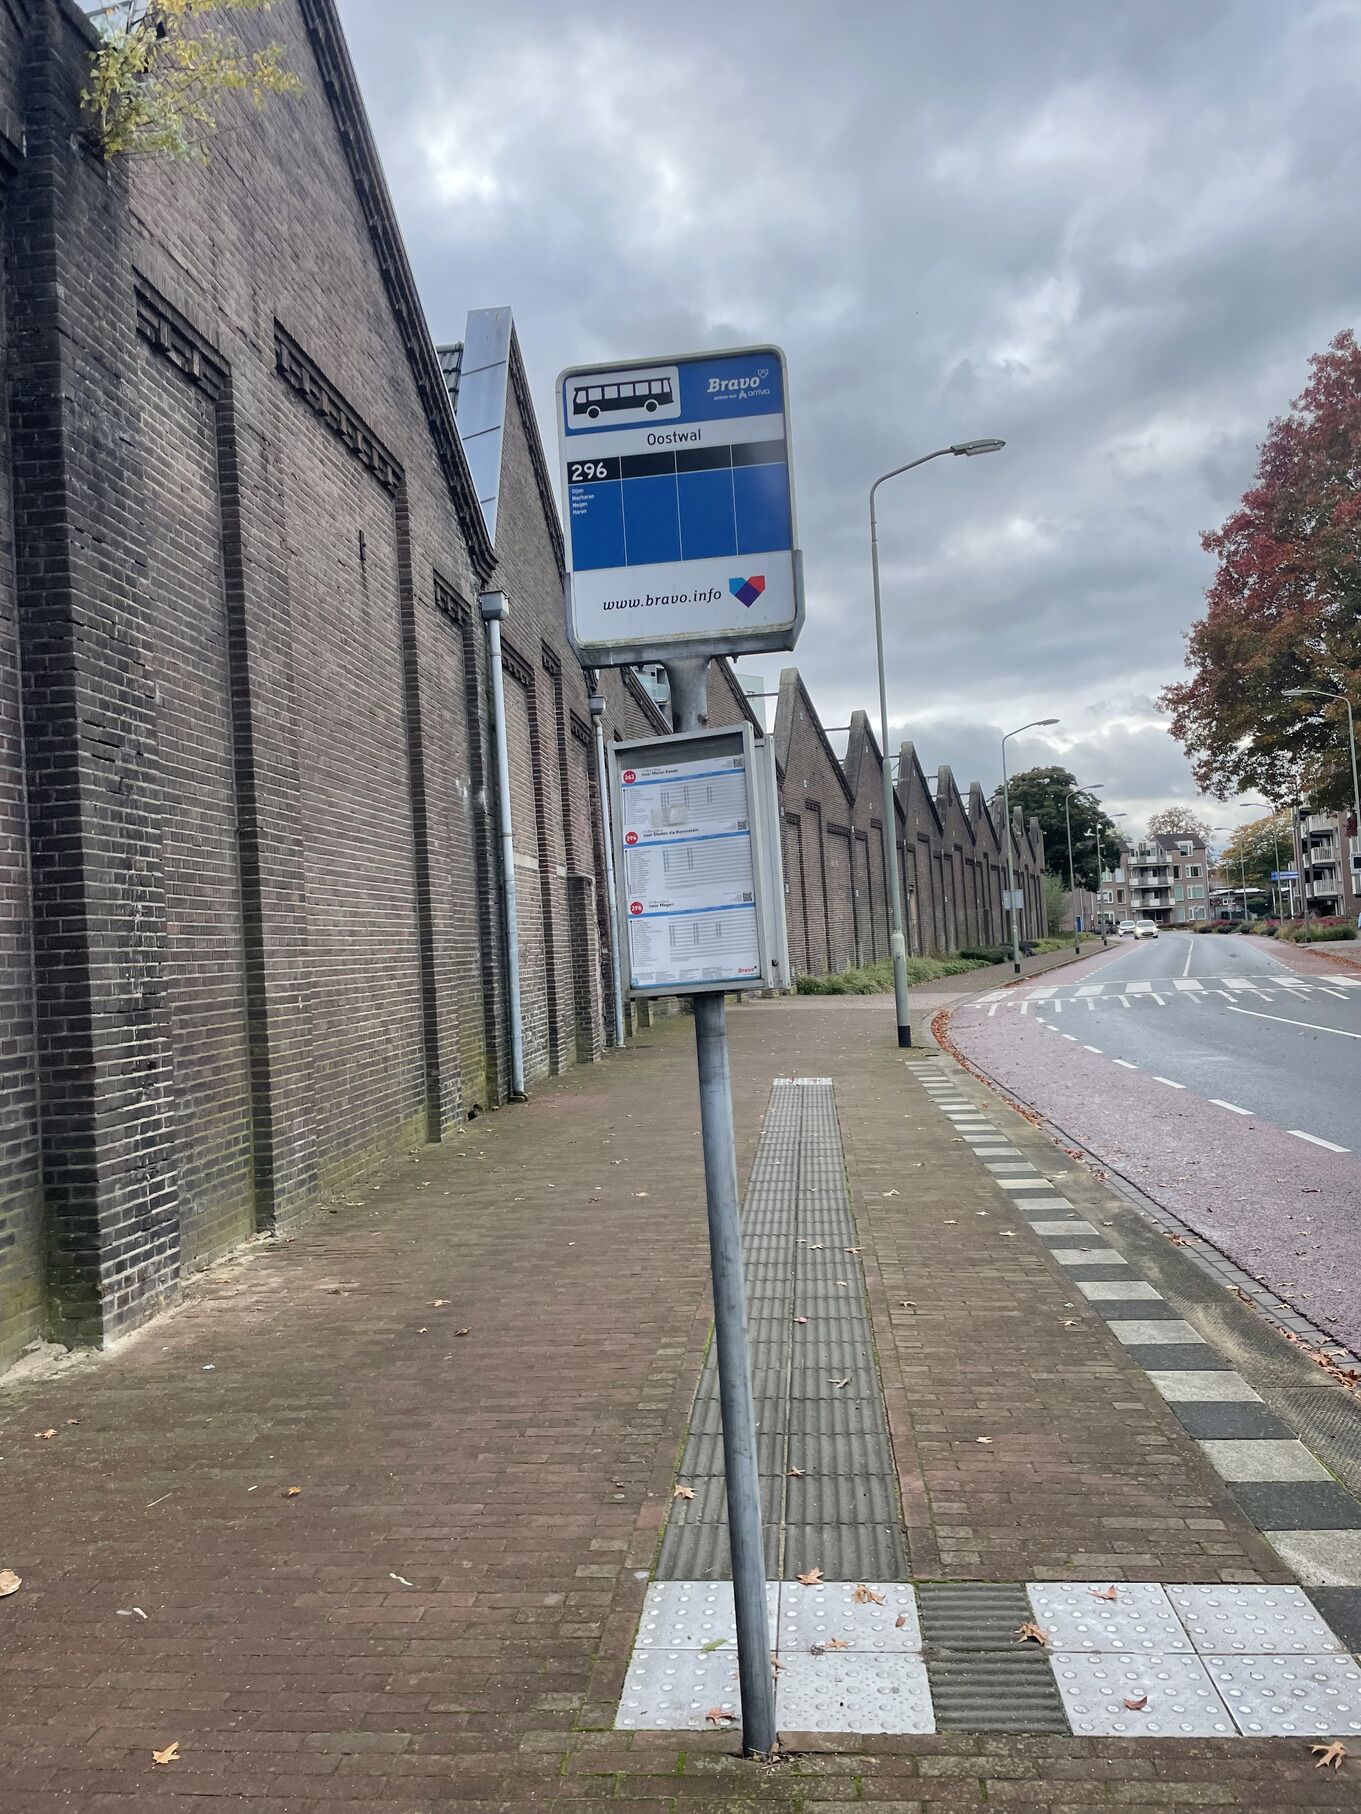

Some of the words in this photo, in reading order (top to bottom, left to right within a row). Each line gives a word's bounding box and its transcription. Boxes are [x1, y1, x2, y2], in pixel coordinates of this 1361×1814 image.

[707, 377, 760, 392] Bravo
[647, 429, 701, 446] Oostwal
[571, 462, 608, 481] 296
[602, 588, 722, 611] www.bravo.info
